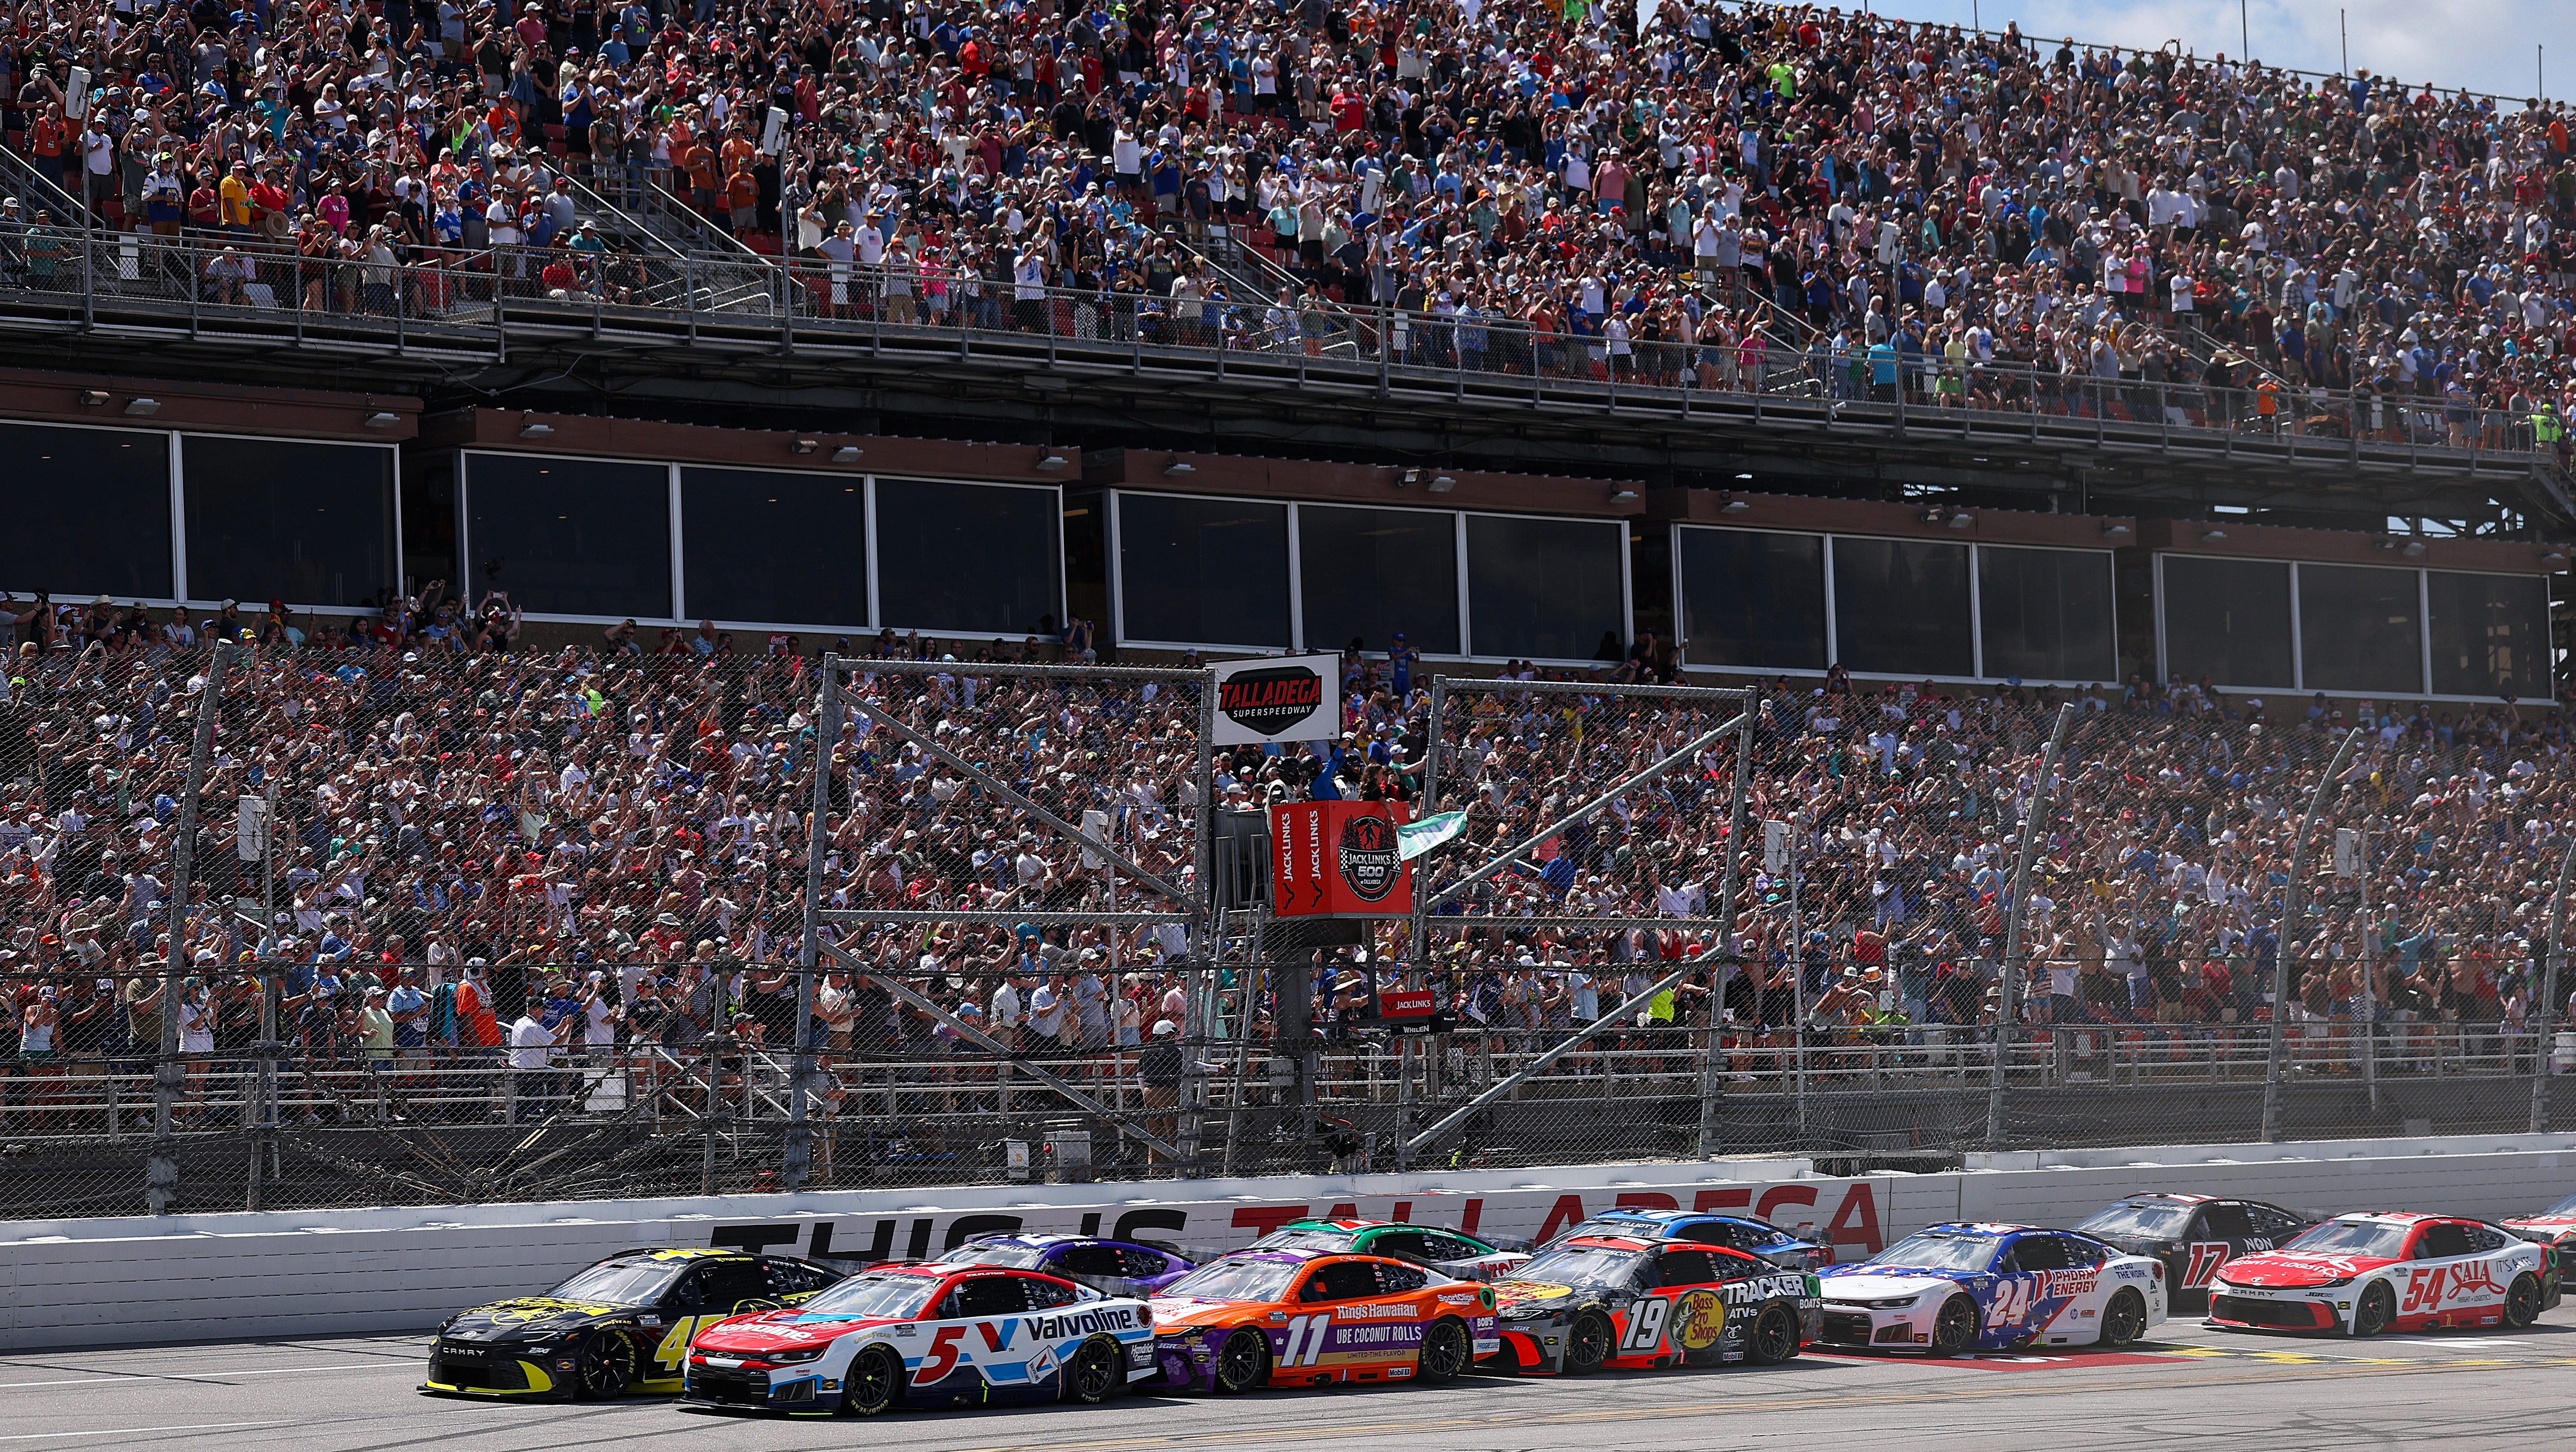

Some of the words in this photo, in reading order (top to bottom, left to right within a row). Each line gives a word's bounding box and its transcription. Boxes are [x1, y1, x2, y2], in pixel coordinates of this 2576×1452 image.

[1220, 678, 1320, 708] TALLADEGA
[1233, 705, 1312, 718] SUPERSPEEDWAY
[1342, 787, 1359, 795] OFFIC
[1281, 813, 1292, 850] LINK'S
[1309, 810, 1320, 848] LINK'S
[1283, 850, 1294, 882] JACK
[1311, 848, 1321, 880] JACK
[1348, 853, 1368, 865] JACK
[1368, 854, 1391, 865] LINK'S
[1358, 866, 1384, 877] 500
[1396, 1001, 1412, 1010] JACK
[1412, 999, 1431, 1008] LINK'S
[1403, 1025, 1430, 1034] WHELEN
[1620, 1221, 1658, 1229] ELLIOTT
[1307, 1232, 1352, 1240] KESELOWSK
[1592, 1248, 1636, 1258] BRISCOE
[633, 1262, 673, 1271] REDDICK
[1252, 1261, 1295, 1270] HAMLIN
[2180, 1241, 2231, 1289] 17
[2496, 1259, 2512, 1273] IT'S
[887, 1276, 928, 1285] LARSON
[2115, 1271, 2131, 1279] THE
[2447, 1259, 2492, 1293] SAIA
[1722, 1275, 1806, 1304] TRACKER
[2054, 1280, 2098, 1295] ENERGY
[2232, 1289, 2275, 1297] CAMRY
[2401, 1267, 2447, 1312] 54
[1437, 1293, 1476, 1302] SportClips
[1691, 1293, 1713, 1309] Bass
[1799, 1297, 1821, 1309] BOATS
[1986, 1279, 2032, 1328] 24
[1335, 1305, 1368, 1319] King's
[1368, 1303, 1418, 1317] Hawaiian
[1691, 1309, 1709, 1325] Pro
[594, 1319, 632, 1330] GOODYEAR
[1023, 1307, 1132, 1341] Valvoline
[1476, 1316, 1494, 1327] BOB'S
[1622, 1299, 1670, 1349] 19
[710, 1323, 812, 1342] Valvoline
[853, 1331, 892, 1344] GOODYEAR
[1336, 1328, 1352, 1344] UBE
[1354, 1326, 1391, 1342] COCONUT
[1392, 1325, 1422, 1341] ROLLS
[1690, 1324, 1718, 1343] Shops
[1279, 1313, 1332, 1367] 11
[442, 1347, 486, 1356] CAMRY
[615, 1330, 637, 1374] GOODYEAR
[909, 1325, 968, 1387] 5
[1131, 1343, 1155, 1357] Hendrick
[1723, 1352, 1737, 1360] Mobil
[1028, 1361, 1040, 1382] VALVOLINE
[1389, 1368, 1404, 1376] Mobil
[851, 1398, 888, 1415] GOODYEAR
